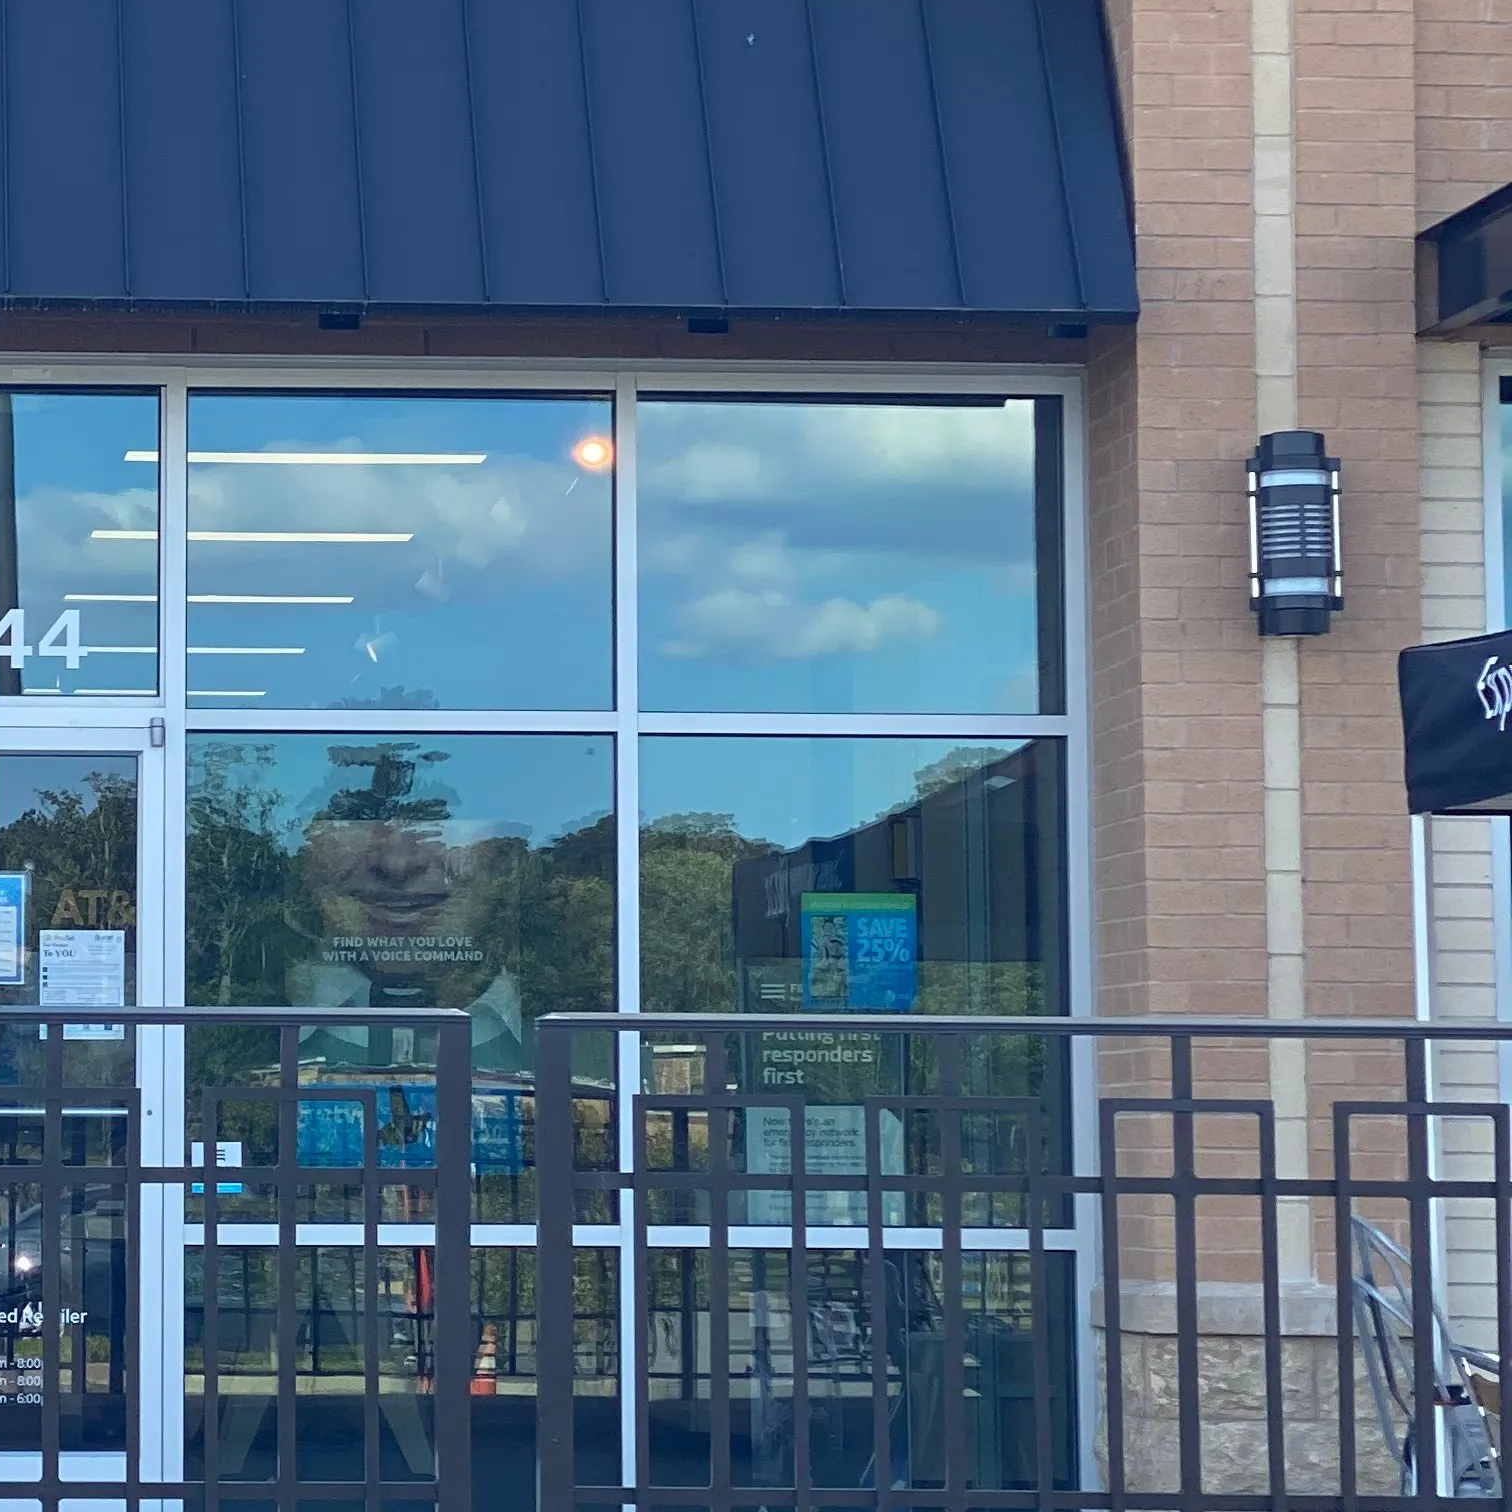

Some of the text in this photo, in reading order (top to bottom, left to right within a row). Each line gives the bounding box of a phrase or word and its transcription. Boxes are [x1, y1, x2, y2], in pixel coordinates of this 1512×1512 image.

[51, 889, 136, 926] AT&
[856, 917, 908, 938] SAVE
[333, 936, 473, 948] FIND WHAT YOU LOVE
[856, 938, 910, 963] 25%
[322, 950, 484, 962] WITH A VOICE COMMAND
[763, 1045, 874, 1066] responders
[763, 1067, 805, 1084] first
[23, 1307, 88, 1324] Reiler
[17, 1358, 44, 1373] 8:00
[17, 1375, 44, 1389] 8:00
[17, 1393, 44, 1407] 6:00
